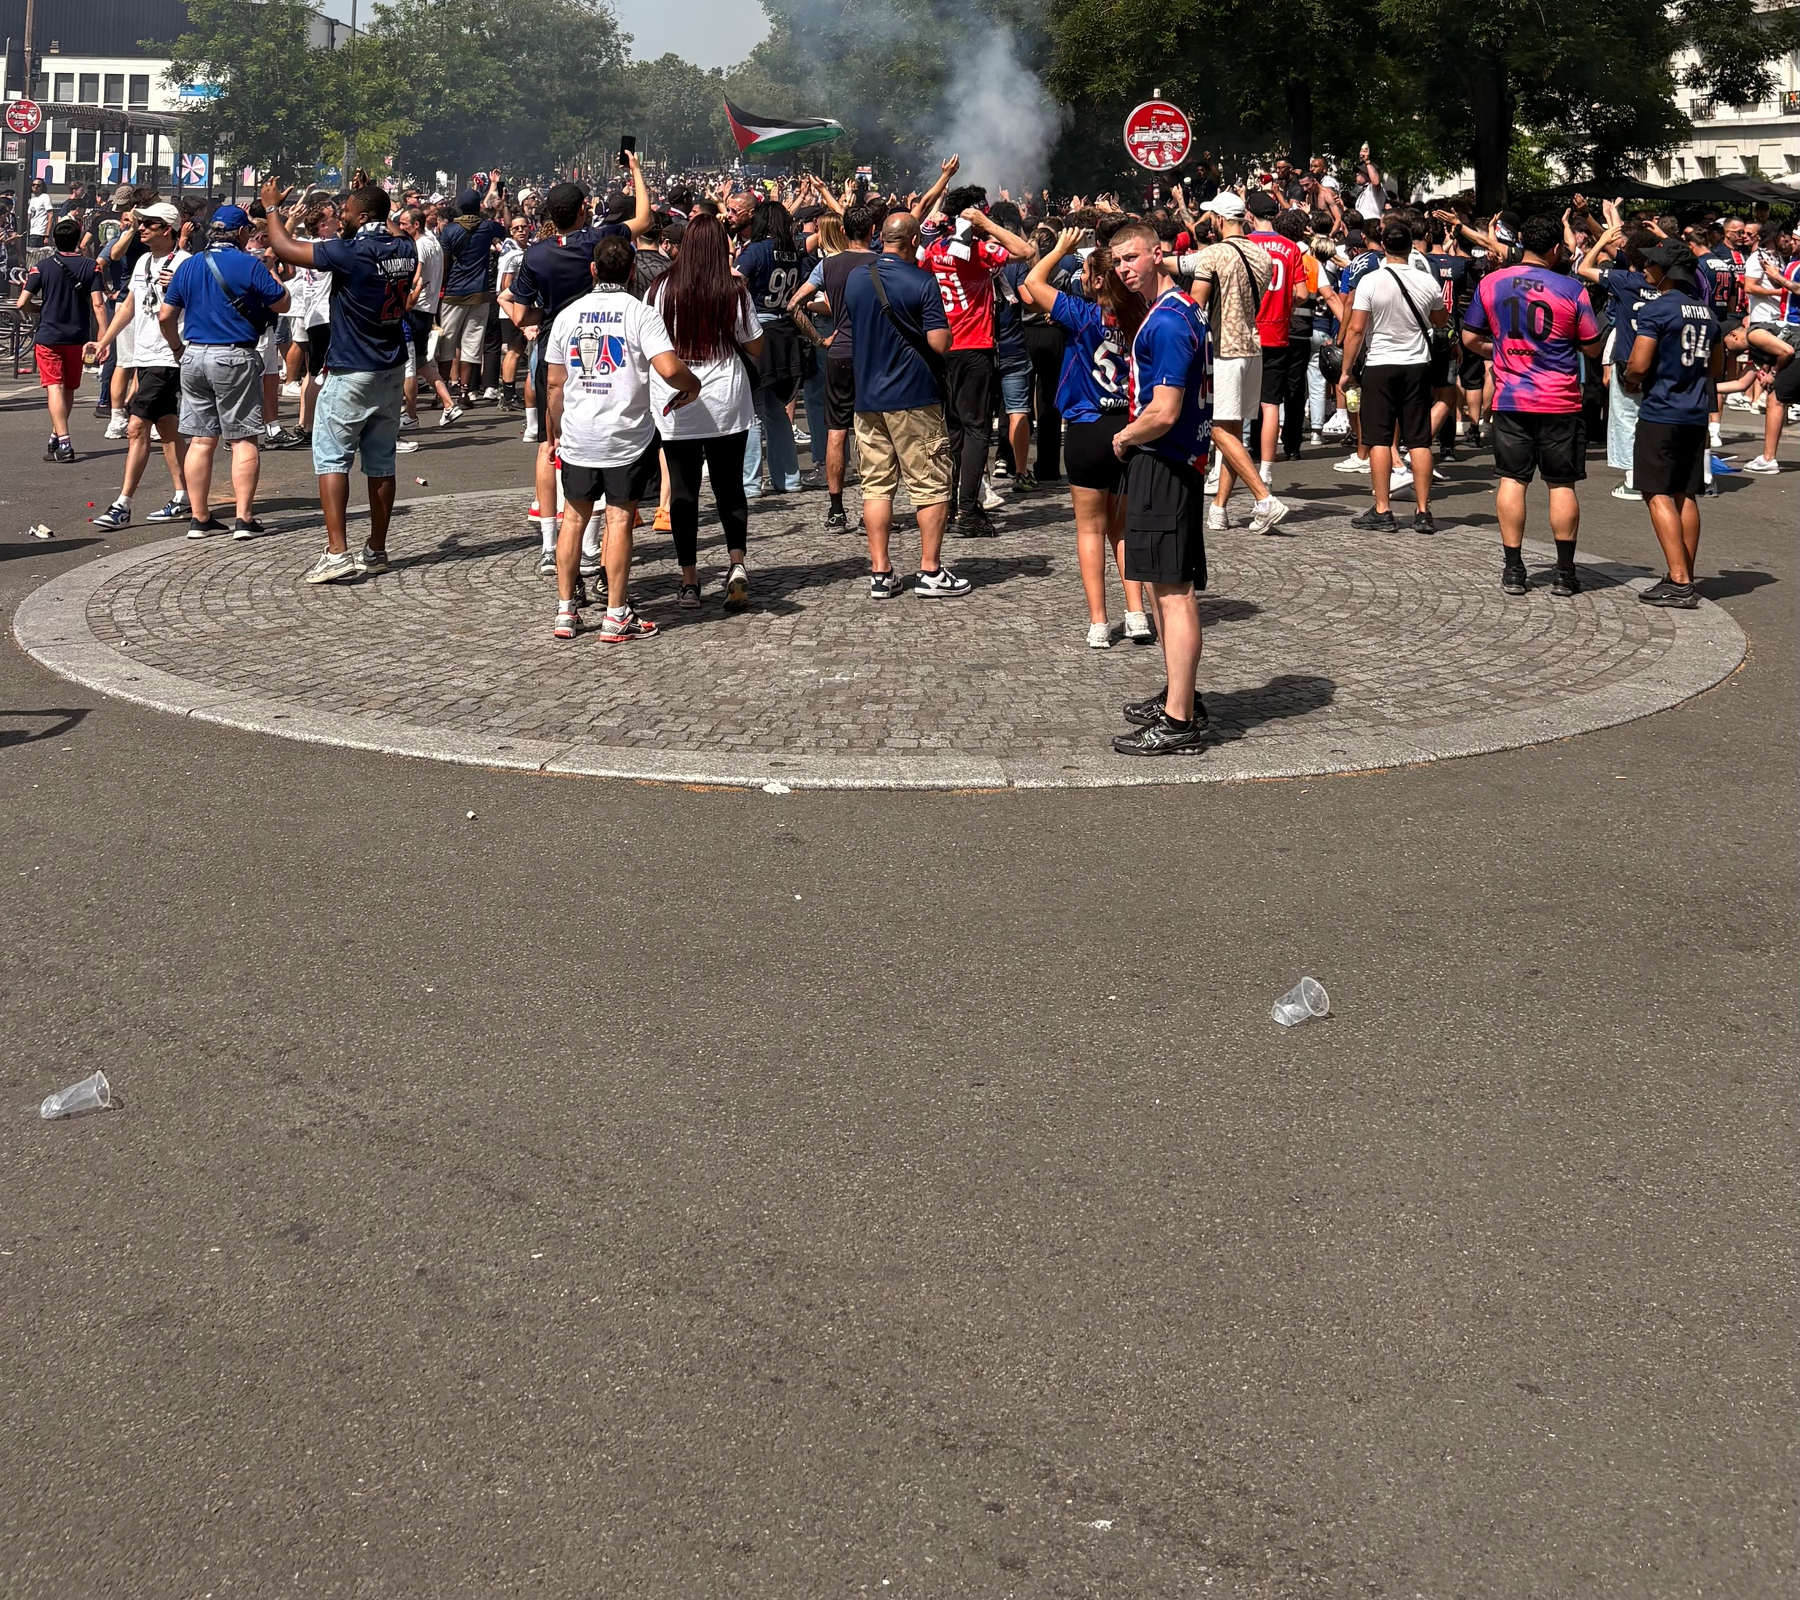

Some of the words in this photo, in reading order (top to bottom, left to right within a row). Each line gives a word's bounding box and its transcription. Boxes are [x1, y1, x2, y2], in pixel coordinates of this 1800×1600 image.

[1258, 241, 1292, 259] EMBELE
[1512, 277, 1545, 293] PSG
[578, 311, 624, 324] FINALE
[1502, 296, 1554, 342] 10
[1680, 323, 1711, 368] 94
